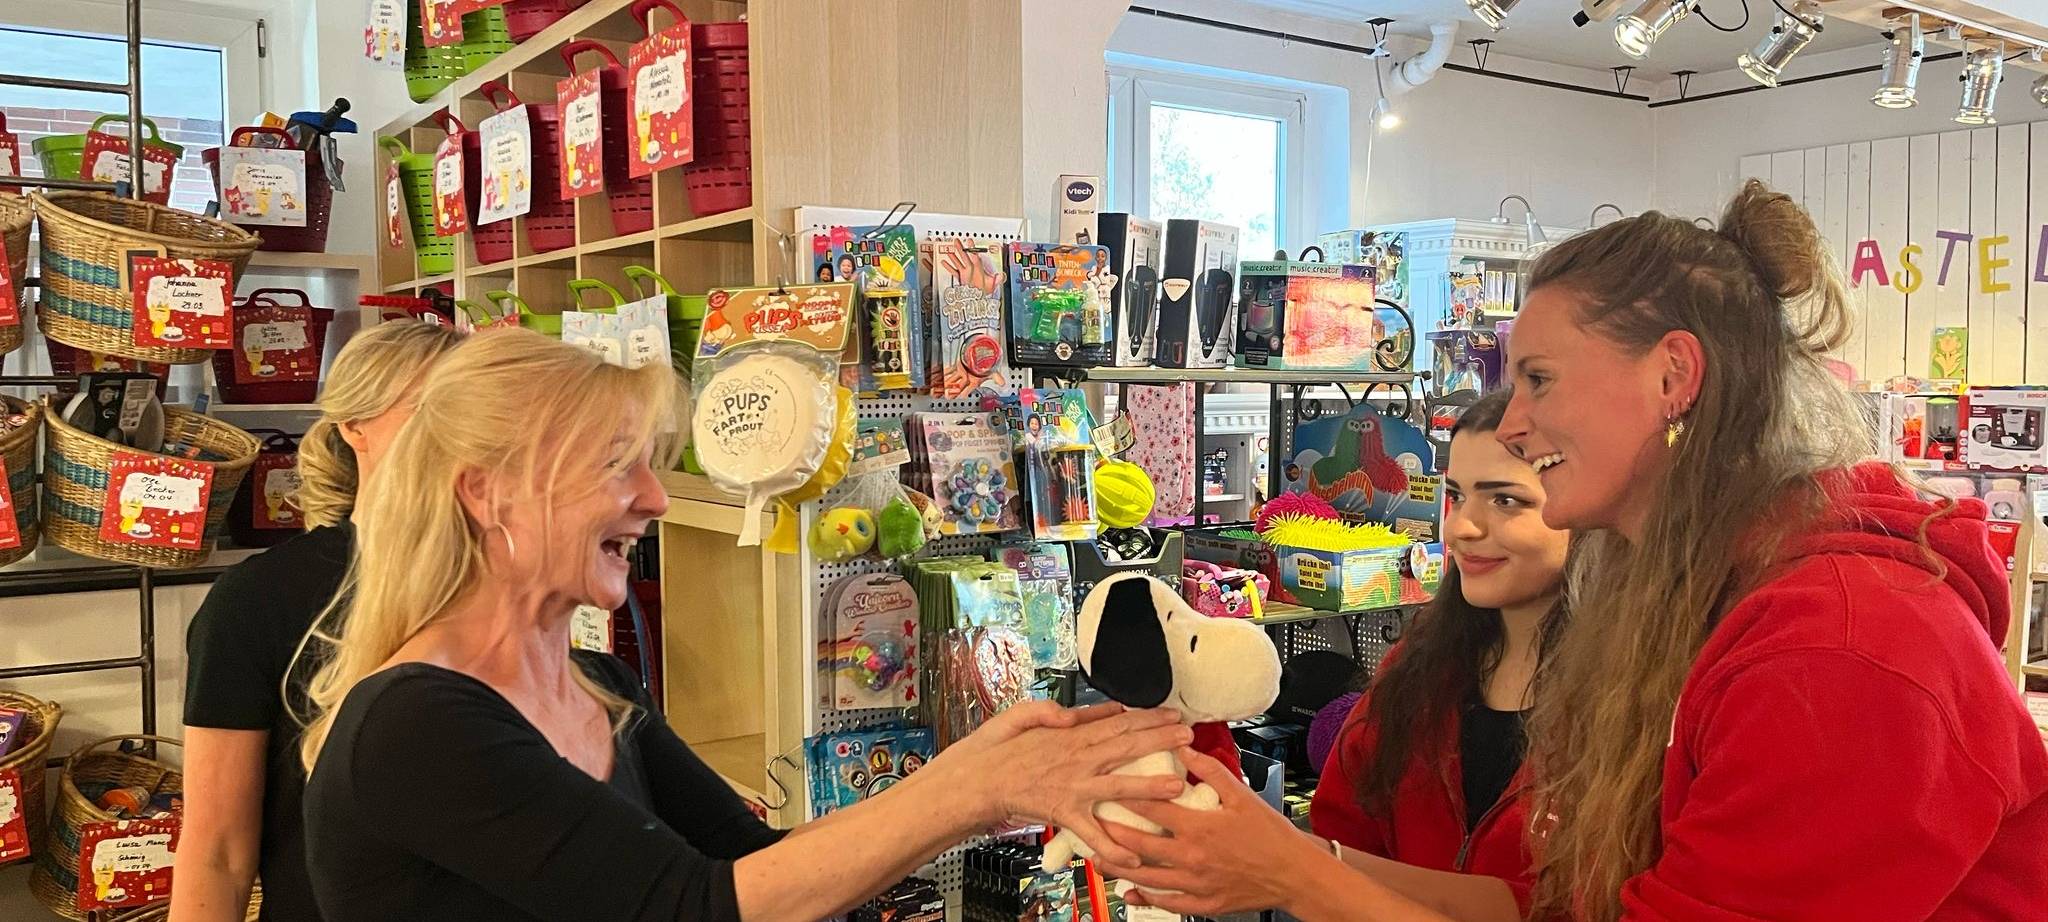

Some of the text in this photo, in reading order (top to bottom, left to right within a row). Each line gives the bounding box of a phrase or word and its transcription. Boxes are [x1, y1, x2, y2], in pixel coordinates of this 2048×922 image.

[743, 308, 803, 334] PUPS
[723, 393, 771, 415] PUPS
[712, 412, 746, 437] FART
[729, 422, 763, 437] PROUT
[854, 591, 903, 609] Unicorn
